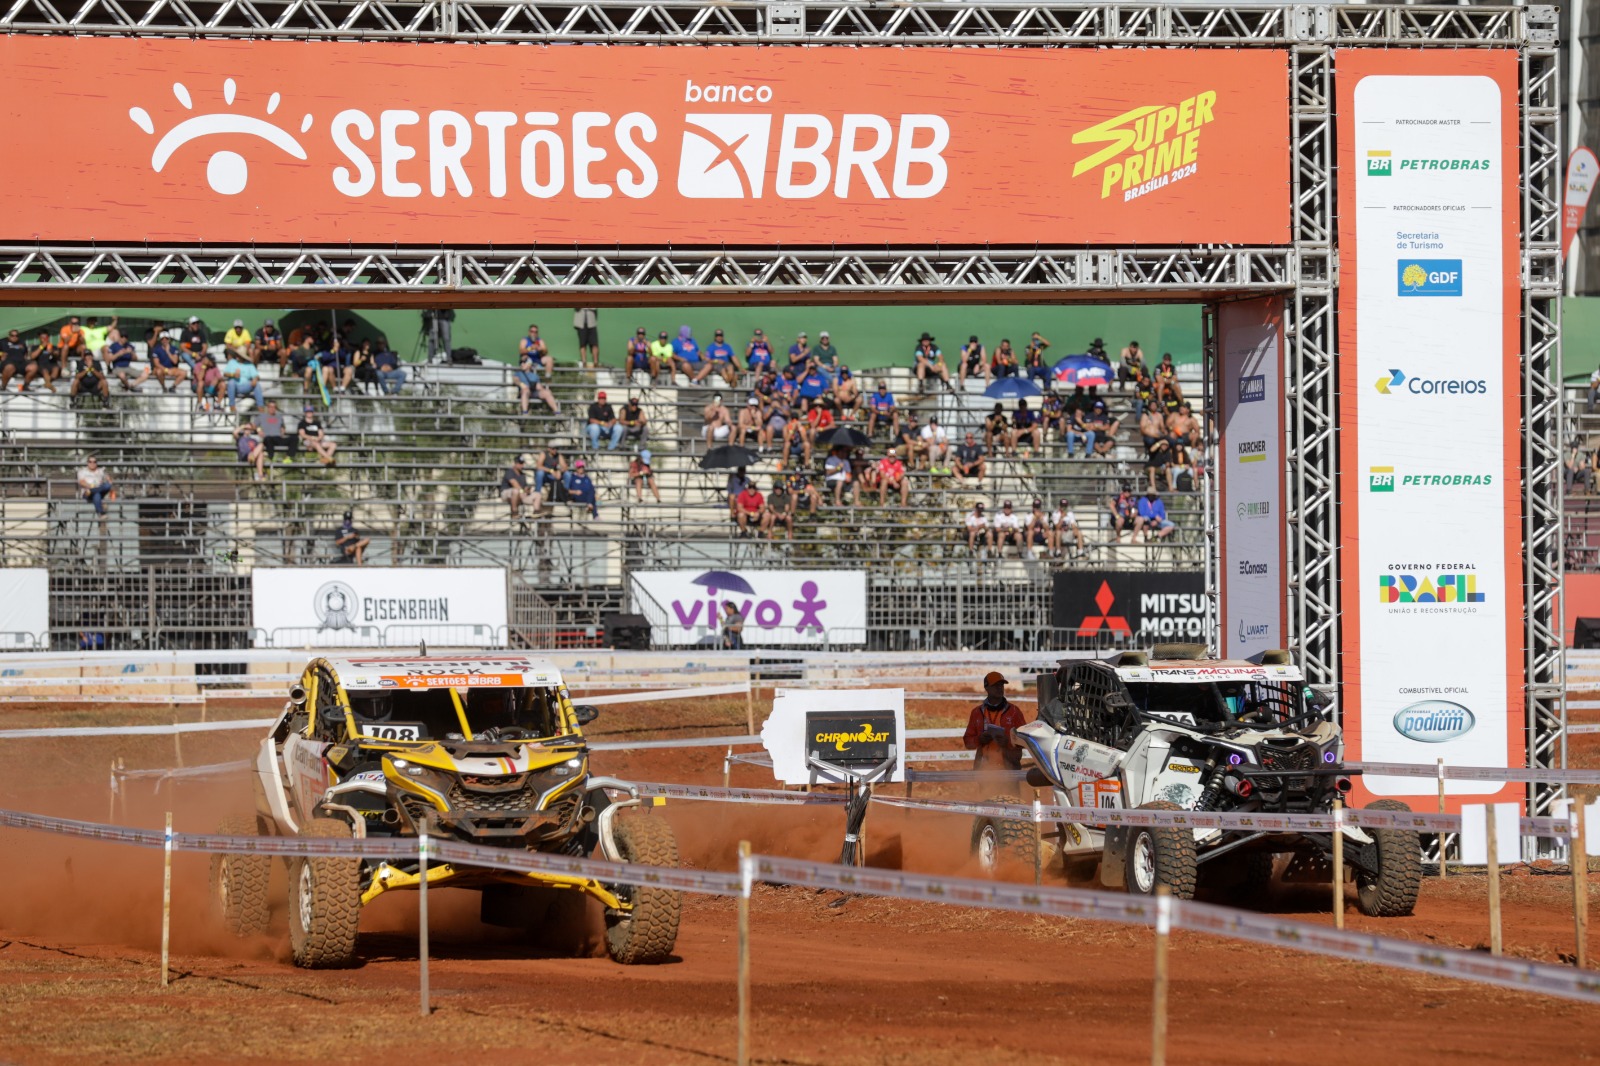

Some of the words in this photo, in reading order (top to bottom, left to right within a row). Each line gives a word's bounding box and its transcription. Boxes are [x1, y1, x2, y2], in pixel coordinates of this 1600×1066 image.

[685, 79, 773, 103] banco
[1071, 89, 1217, 178] SUPER
[330, 108, 658, 198] SERTÕES
[776, 113, 950, 199] BRB
[1101, 128, 1200, 199] PRIME
[1369, 159, 1390, 170] BR
[1400, 159, 1490, 171] PETROBRAS
[1124, 177, 1169, 203] BRASÍLIA
[1171, 162, 1197, 184] 2024
[1396, 231, 1440, 240] Secretaria
[1396, 241, 1408, 249] de
[1410, 241, 1444, 249] Turismo
[1429, 271, 1458, 284] GDF
[1408, 377, 1487, 395] Correios
[1371, 475, 1392, 486] BR
[1402, 474, 1492, 486] PETROBRAS
[1244, 560, 1268, 575] Conasa
[1388, 563, 1432, 571] GOVERNO
[1379, 574, 1486, 603] BRASIL
[363, 596, 450, 622] EISENBAHN
[671, 584, 783, 631] vivo
[1420, 607, 1477, 615] RECONSTRUÇÃO
[1246, 624, 1269, 636] LWART
[407, 668, 485, 676] ROCK
[479, 676, 502, 686] BRB
[1398, 686, 1442, 694] COMBUSTÍVEL
[1444, 686, 1469, 694] OFICIAL
[1403, 712, 1464, 734] podium
[371, 727, 415, 742] 108
